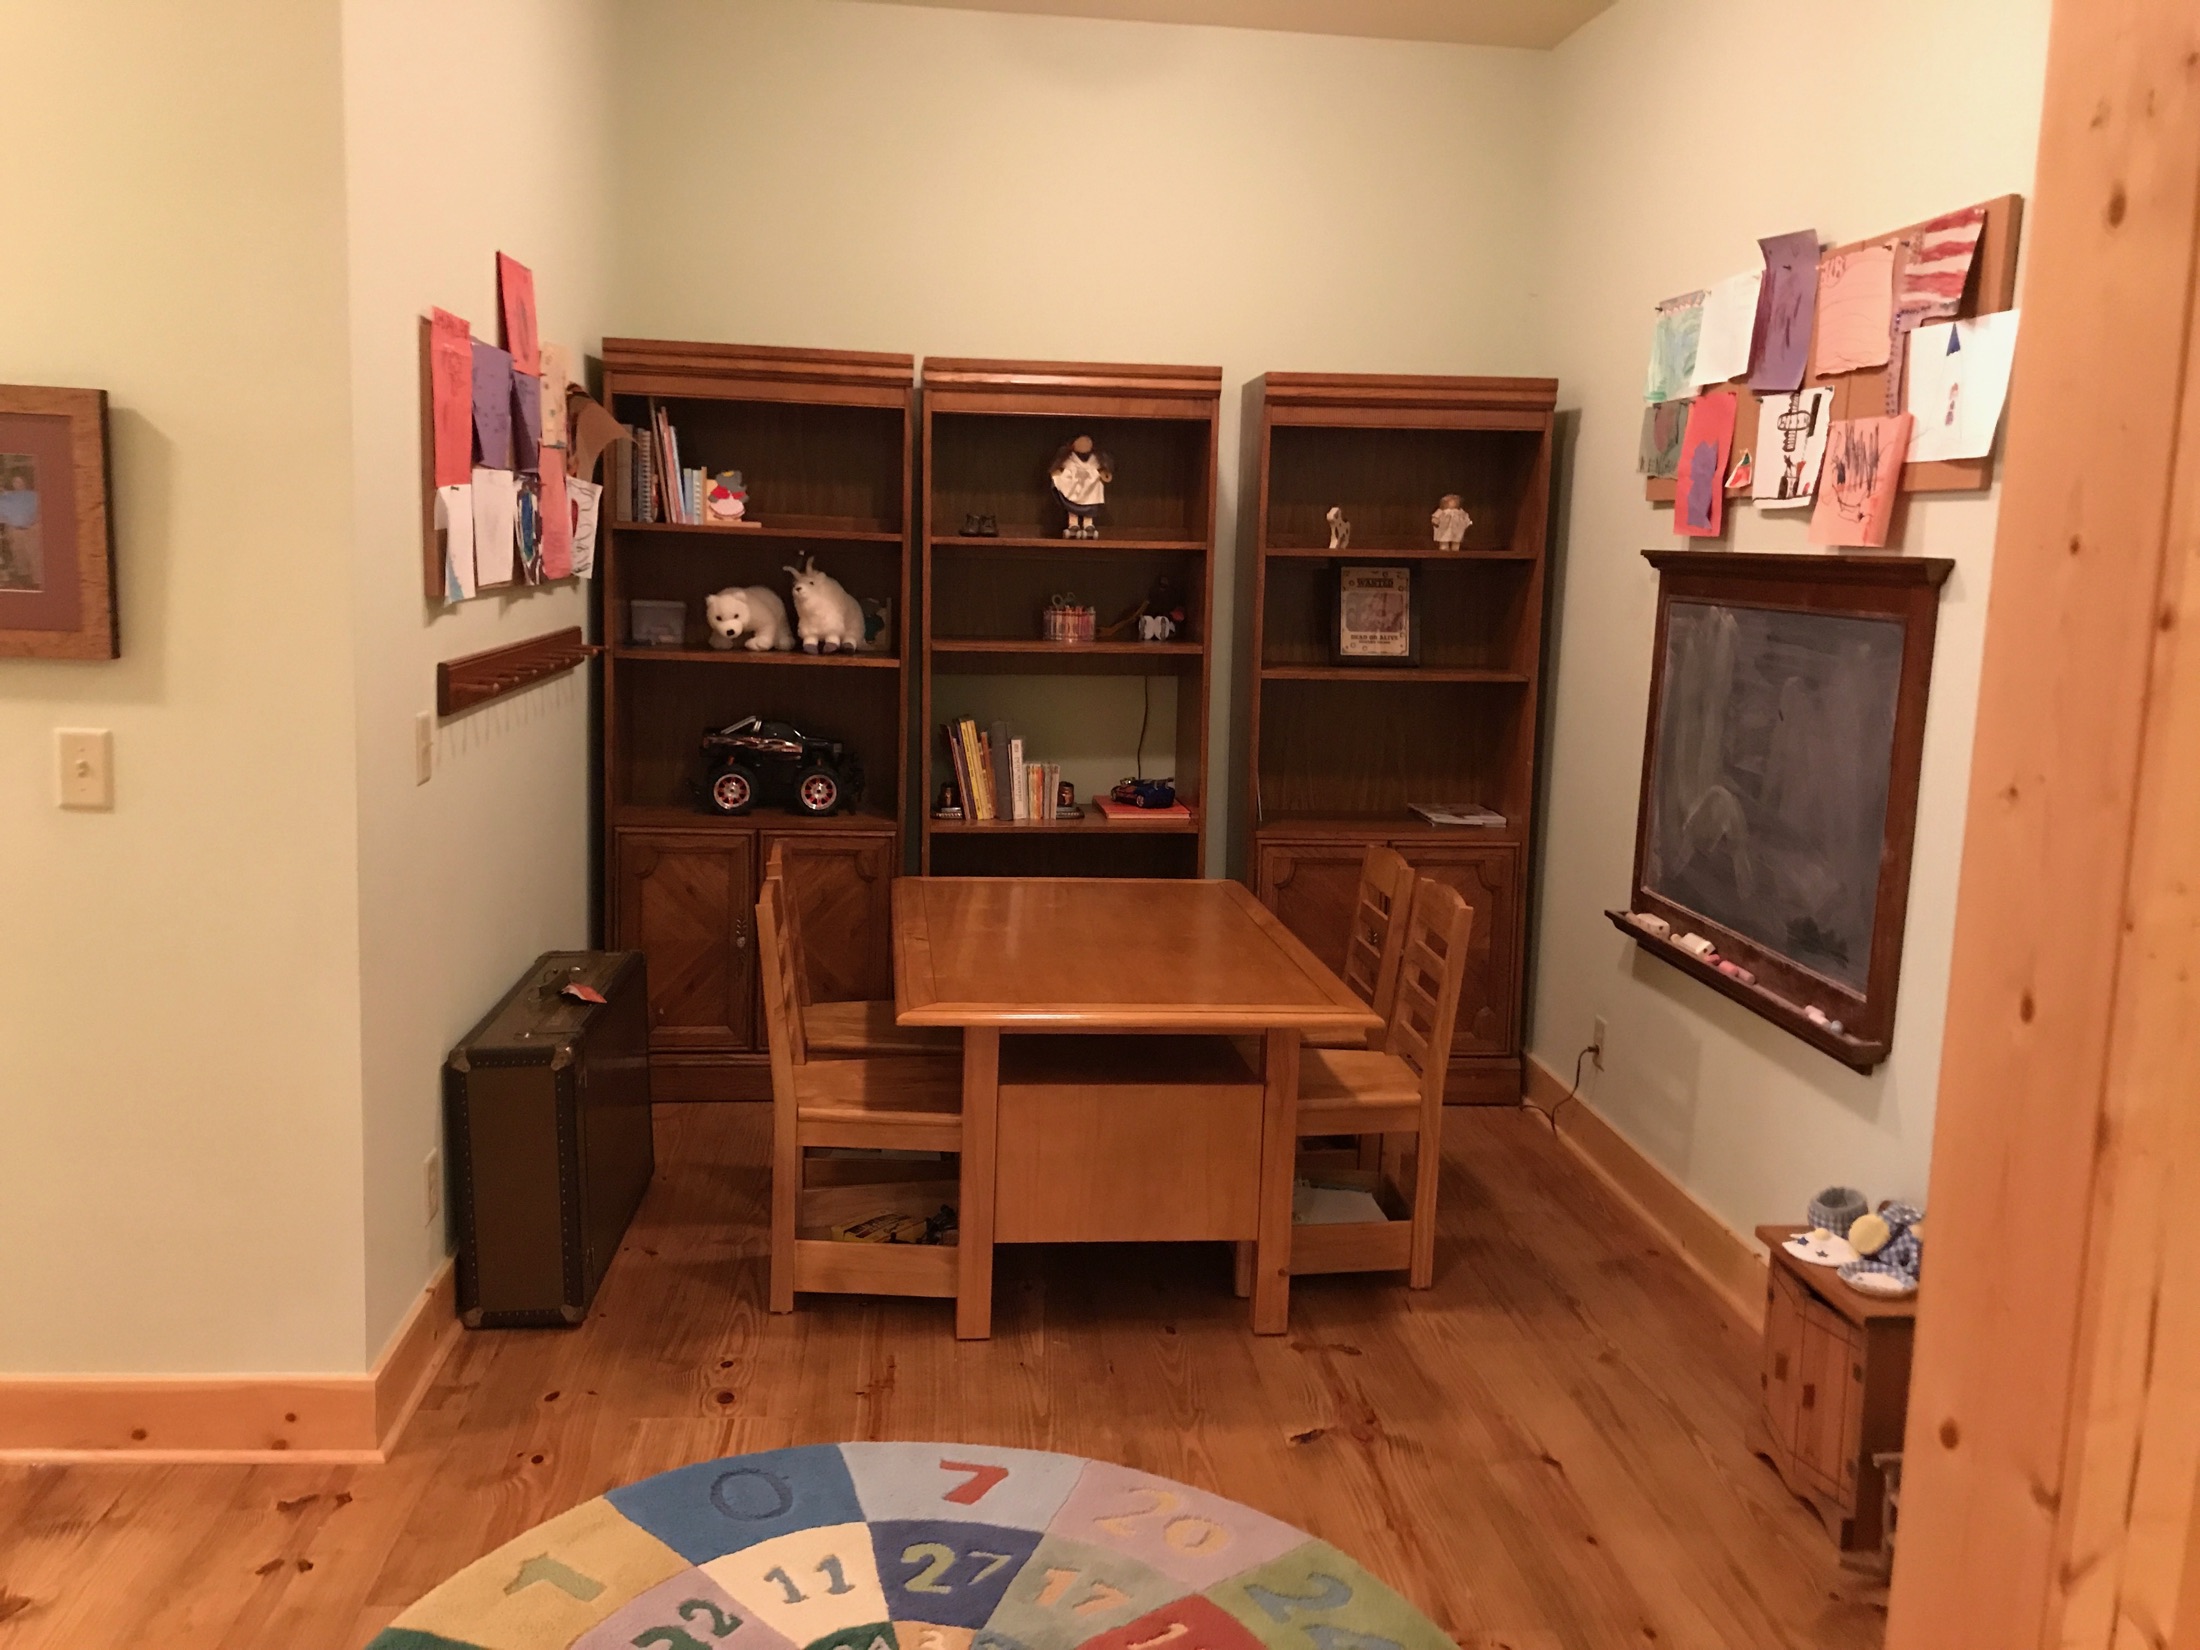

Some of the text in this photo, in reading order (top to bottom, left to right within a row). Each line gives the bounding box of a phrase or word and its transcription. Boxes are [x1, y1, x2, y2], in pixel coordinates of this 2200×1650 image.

[1357, 578, 1393, 589] WANTED
[939, 1459, 1008, 1505] 7
[1093, 1486, 1235, 1559] 20
[763, 1554, 856, 1604] 11
[901, 1542, 1014, 1595] 27
[1034, 1566, 1134, 1617] 17
